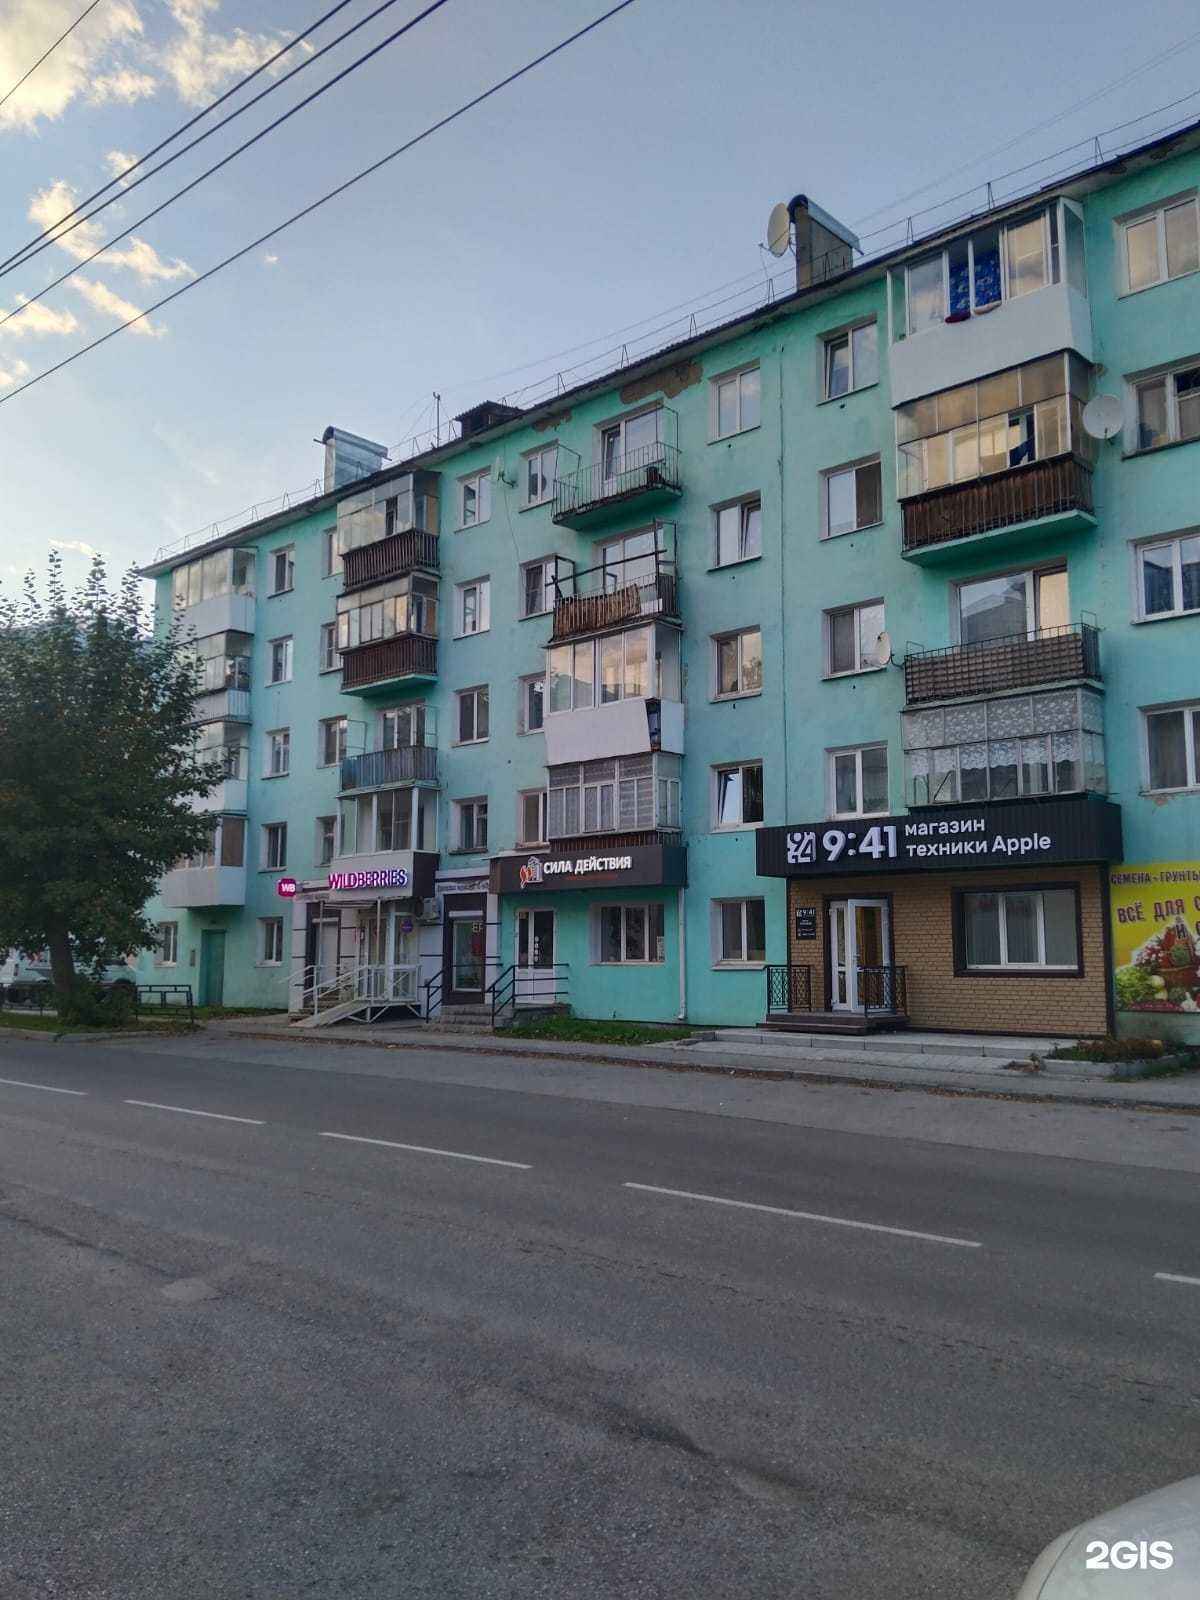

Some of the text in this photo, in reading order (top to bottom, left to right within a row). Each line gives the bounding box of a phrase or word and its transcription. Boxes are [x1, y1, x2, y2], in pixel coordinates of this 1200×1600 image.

[905, 818, 985, 836] магазин
[822, 825, 898, 861] 9:41
[906, 833, 1051, 857] техники Apple
[543, 856, 632, 875] СИЛА ДЕЙСТВИЯ
[281, 883, 296, 893] WB
[328, 869, 408, 889] WILDBERRIES
[1111, 872, 1151, 885] СЕМЕНА
[1117, 901, 1145, 923] ВСЁ
[1154, 898, 1185, 922] ДЛЯ
